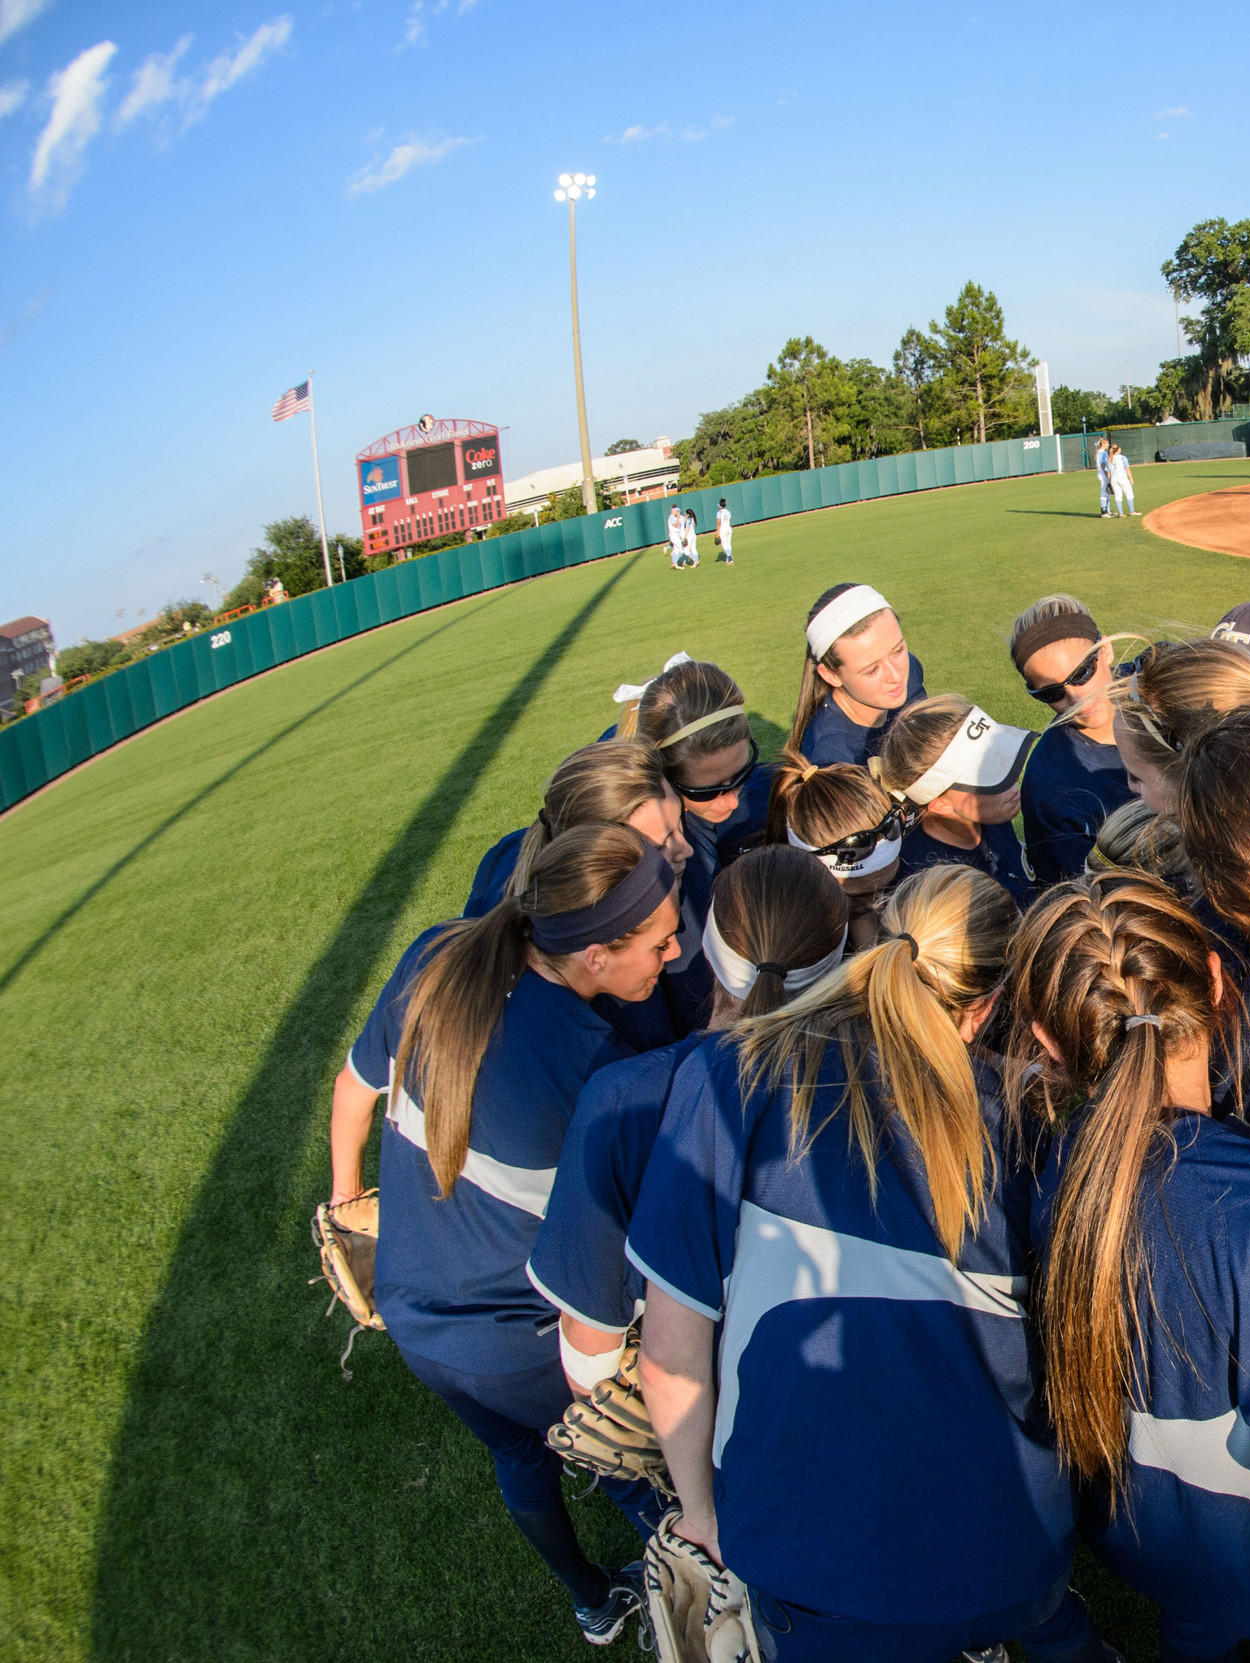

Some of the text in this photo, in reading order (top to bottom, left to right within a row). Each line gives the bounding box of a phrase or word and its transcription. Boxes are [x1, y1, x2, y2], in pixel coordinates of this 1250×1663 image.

[1023, 440, 1040, 450] 200
[465, 447, 496, 463] Coke
[471, 459, 493, 470] zero
[463, 483, 473, 492] OUT
[604, 516, 623, 529] ACC
[210, 630, 232, 649] 220
[967, 717, 990, 740] GT
[830, 863, 864, 871] RUSSELL
